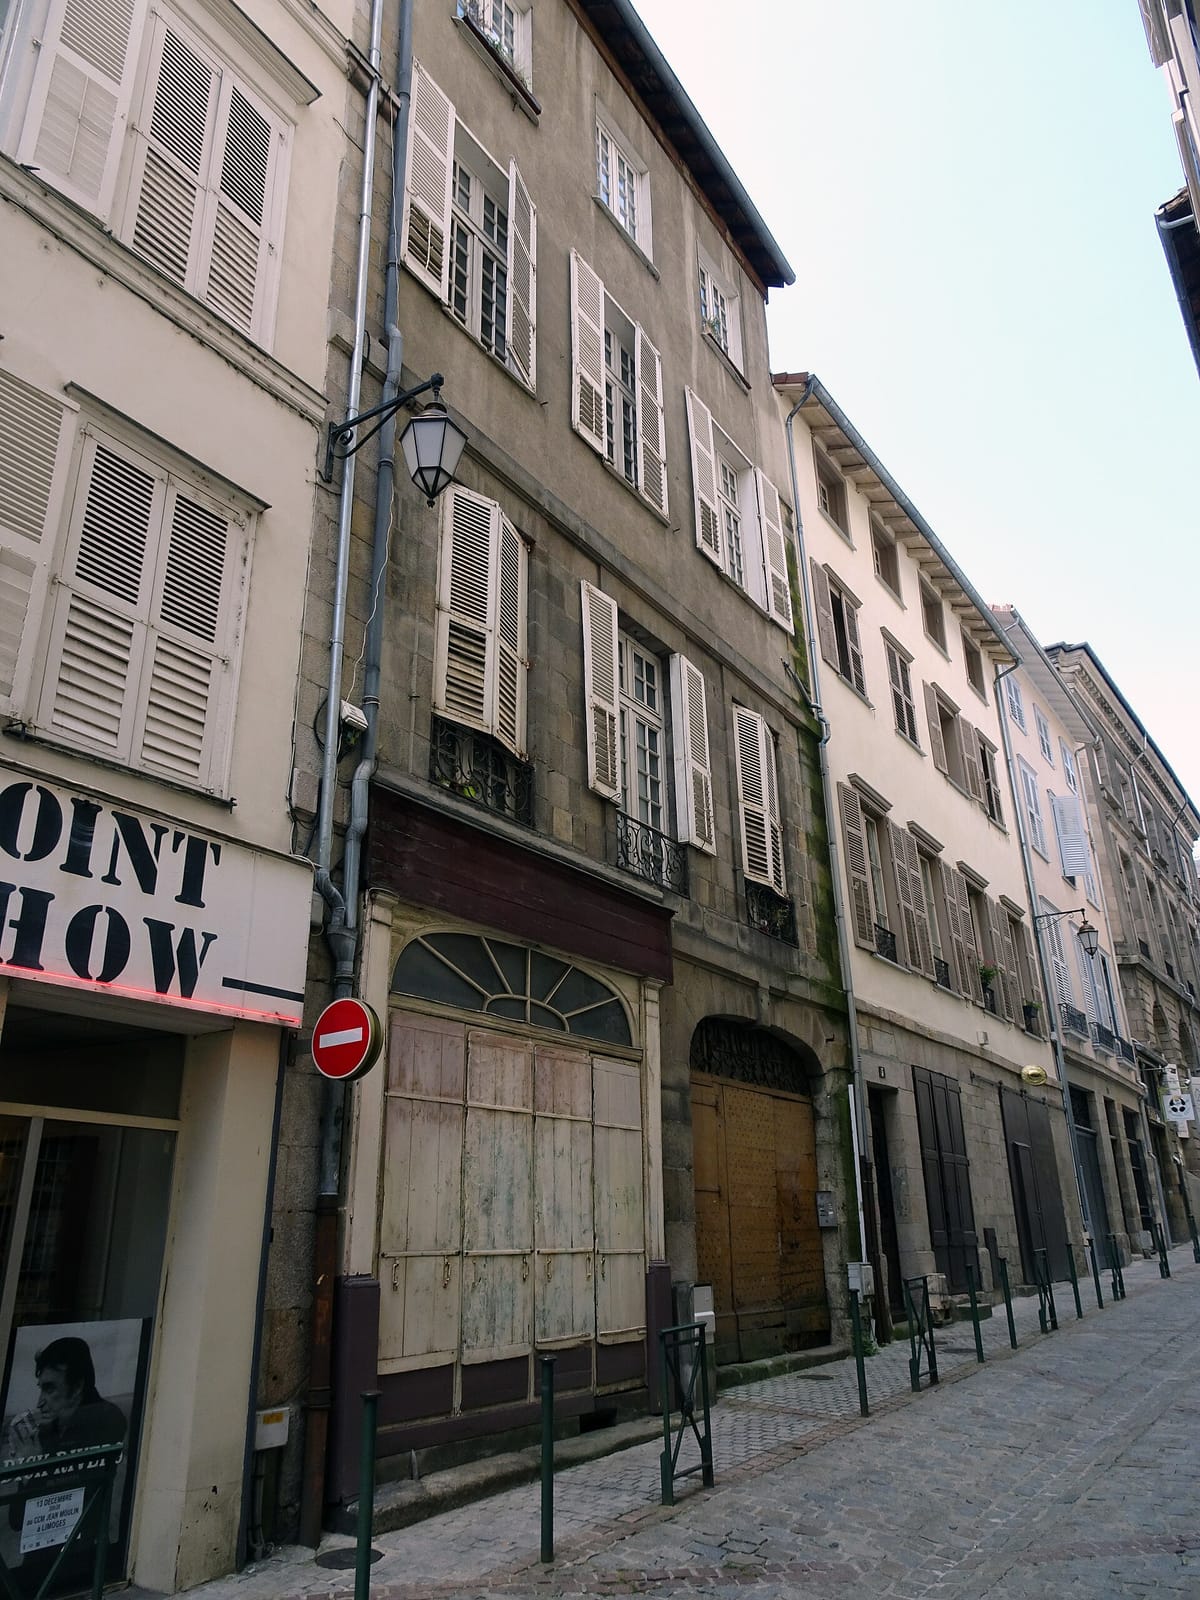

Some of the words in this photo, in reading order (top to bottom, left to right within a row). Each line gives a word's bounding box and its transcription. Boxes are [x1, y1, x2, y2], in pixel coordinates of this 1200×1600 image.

[46, 1511, 59, 1521] JEAN
[59, 1507, 79, 1516] MOULIN
[41, 1519, 66, 1531] LIMOGES
